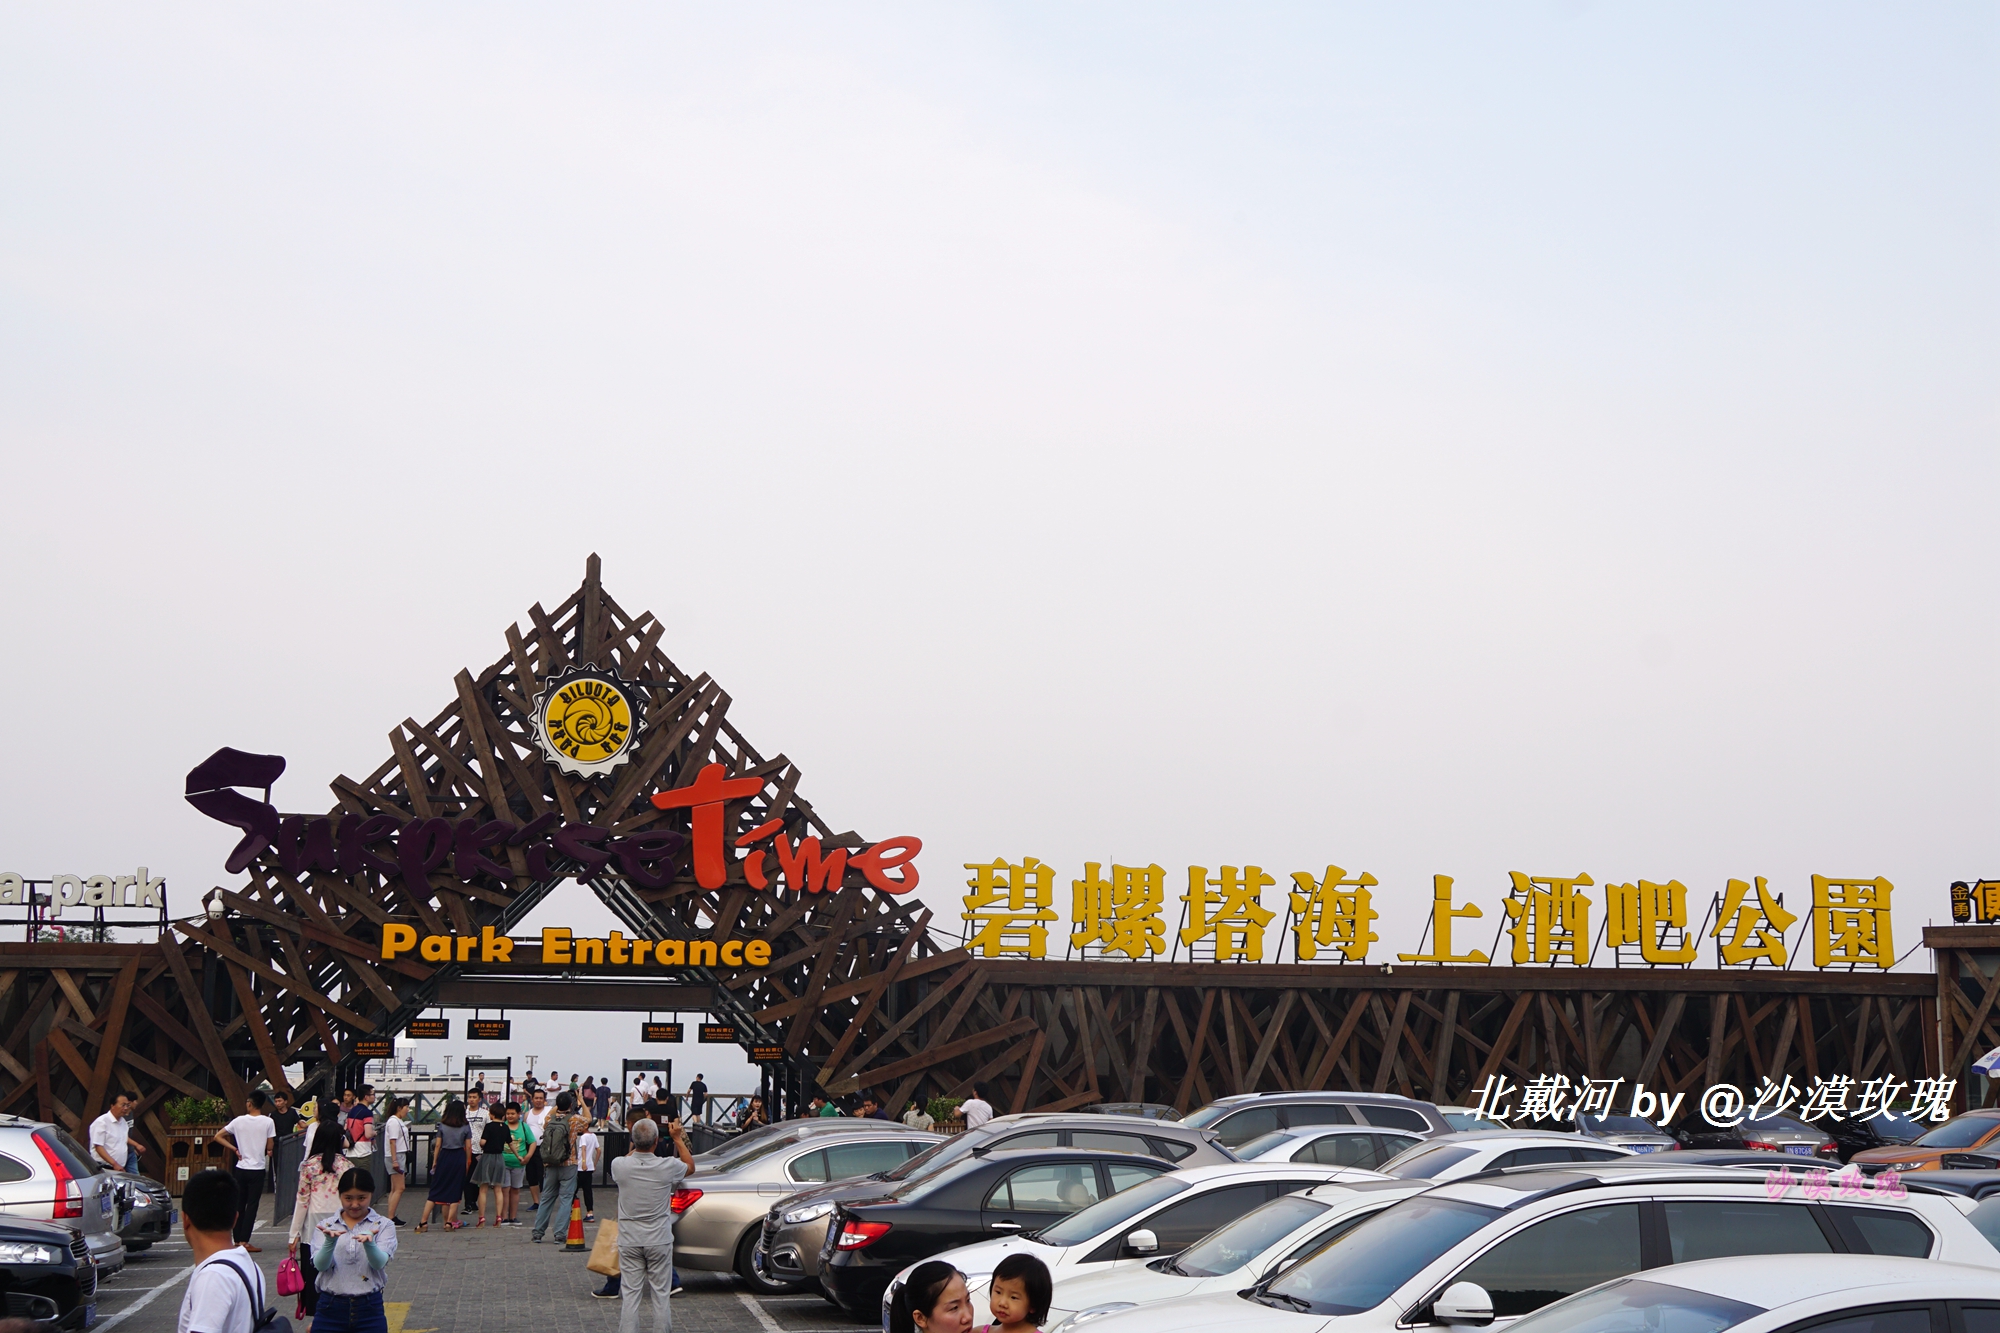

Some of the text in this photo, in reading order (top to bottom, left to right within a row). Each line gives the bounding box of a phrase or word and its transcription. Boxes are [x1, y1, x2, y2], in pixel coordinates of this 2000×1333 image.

[559, 681, 620, 707] BILUOTA
[650, 762, 923, 895] Time
[50, 866, 166, 916] park
[960, 856, 1895, 969] 碧螺塔海上酒吧公園
[1951, 885, 1970, 917] 金勇
[380, 923, 772, 968] Park Entrance
